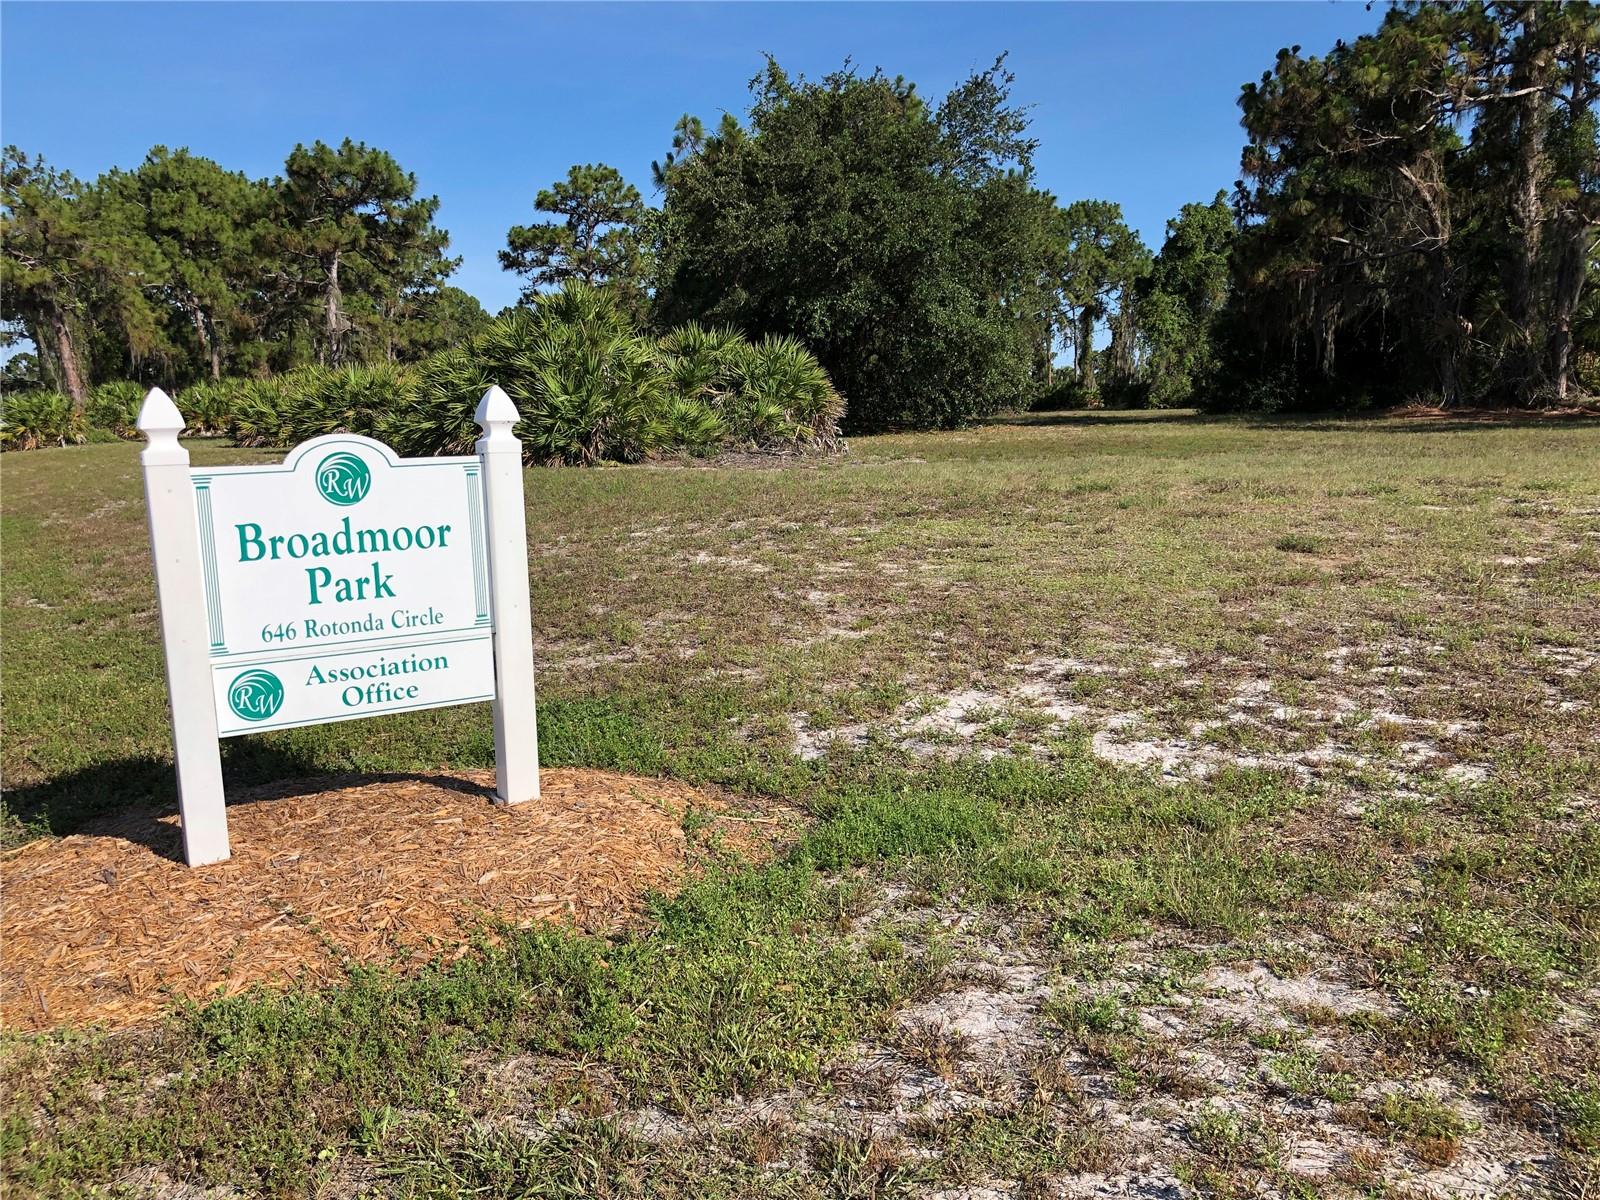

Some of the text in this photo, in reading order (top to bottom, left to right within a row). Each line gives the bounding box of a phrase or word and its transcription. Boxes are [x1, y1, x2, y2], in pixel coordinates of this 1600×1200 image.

[234, 516, 452, 563] Broadmoor
[305, 560, 396, 606] Park
[261, 606, 444, 643] 646 Rotonda Circle
[305, 653, 449, 687] Association
[341, 684, 419, 708] Office
